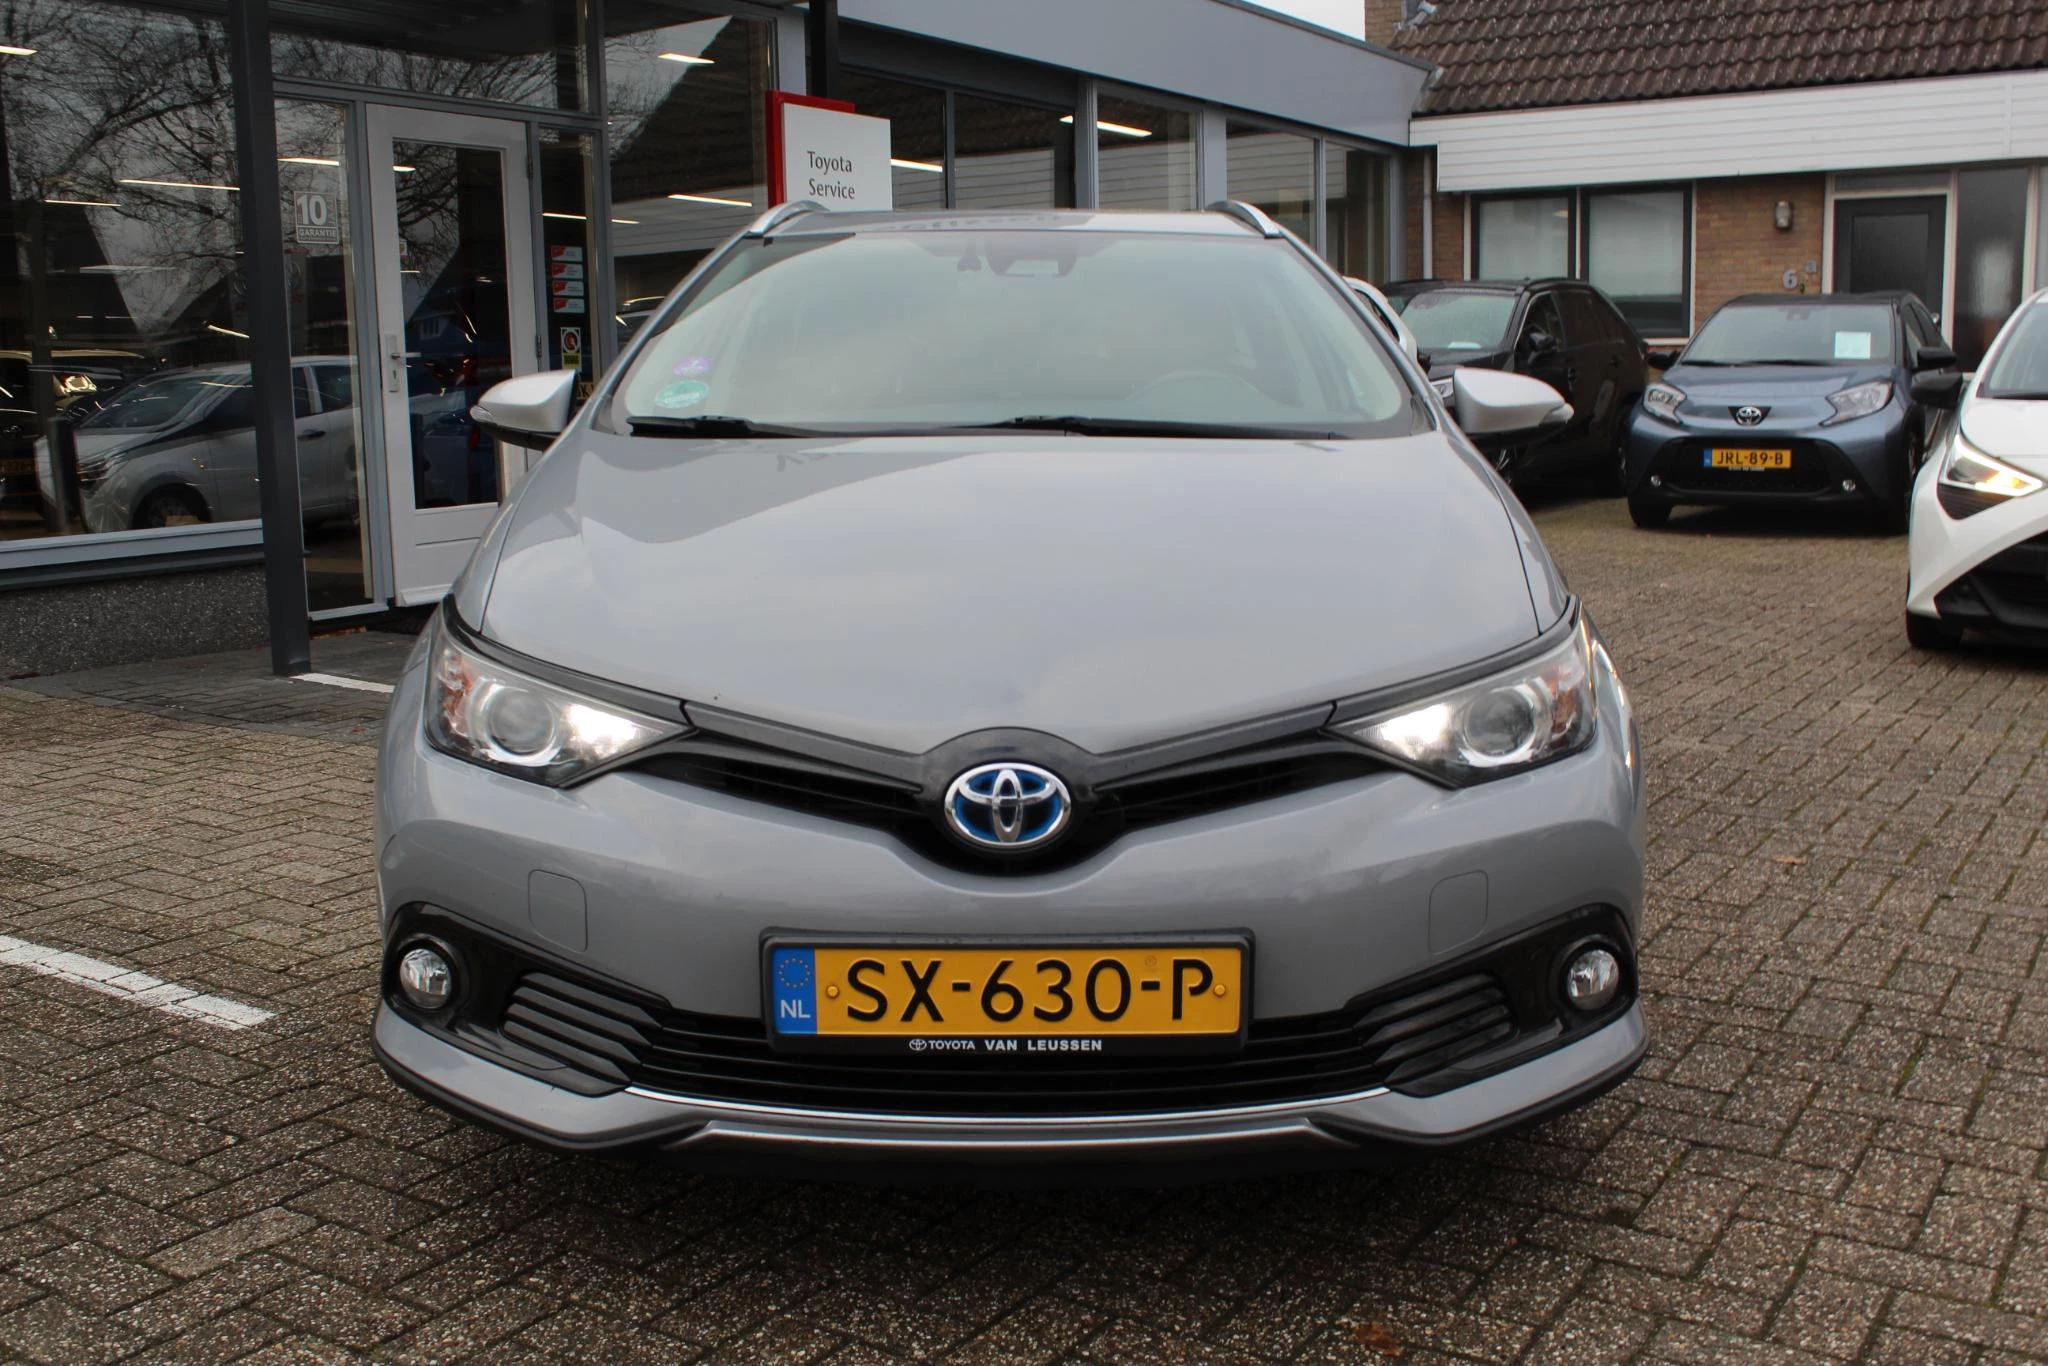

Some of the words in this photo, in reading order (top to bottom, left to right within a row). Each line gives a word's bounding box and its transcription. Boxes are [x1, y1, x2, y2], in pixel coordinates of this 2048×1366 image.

[807, 150, 852, 175] Toyota
[808, 178, 855, 199] Service
[296, 194, 327, 225] 10
[299, 229, 337, 237] GARANTIE
[1716, 451, 1784, 465] JRL-89-B
[846, 959, 1214, 1022] SX-630-P
[780, 999, 811, 1019] NL
[928, 1040, 976, 1050] TOYOTA
[984, 1039, 1018, 1051] VAN
[1027, 1039, 1102, 1051] LEUSSEN
